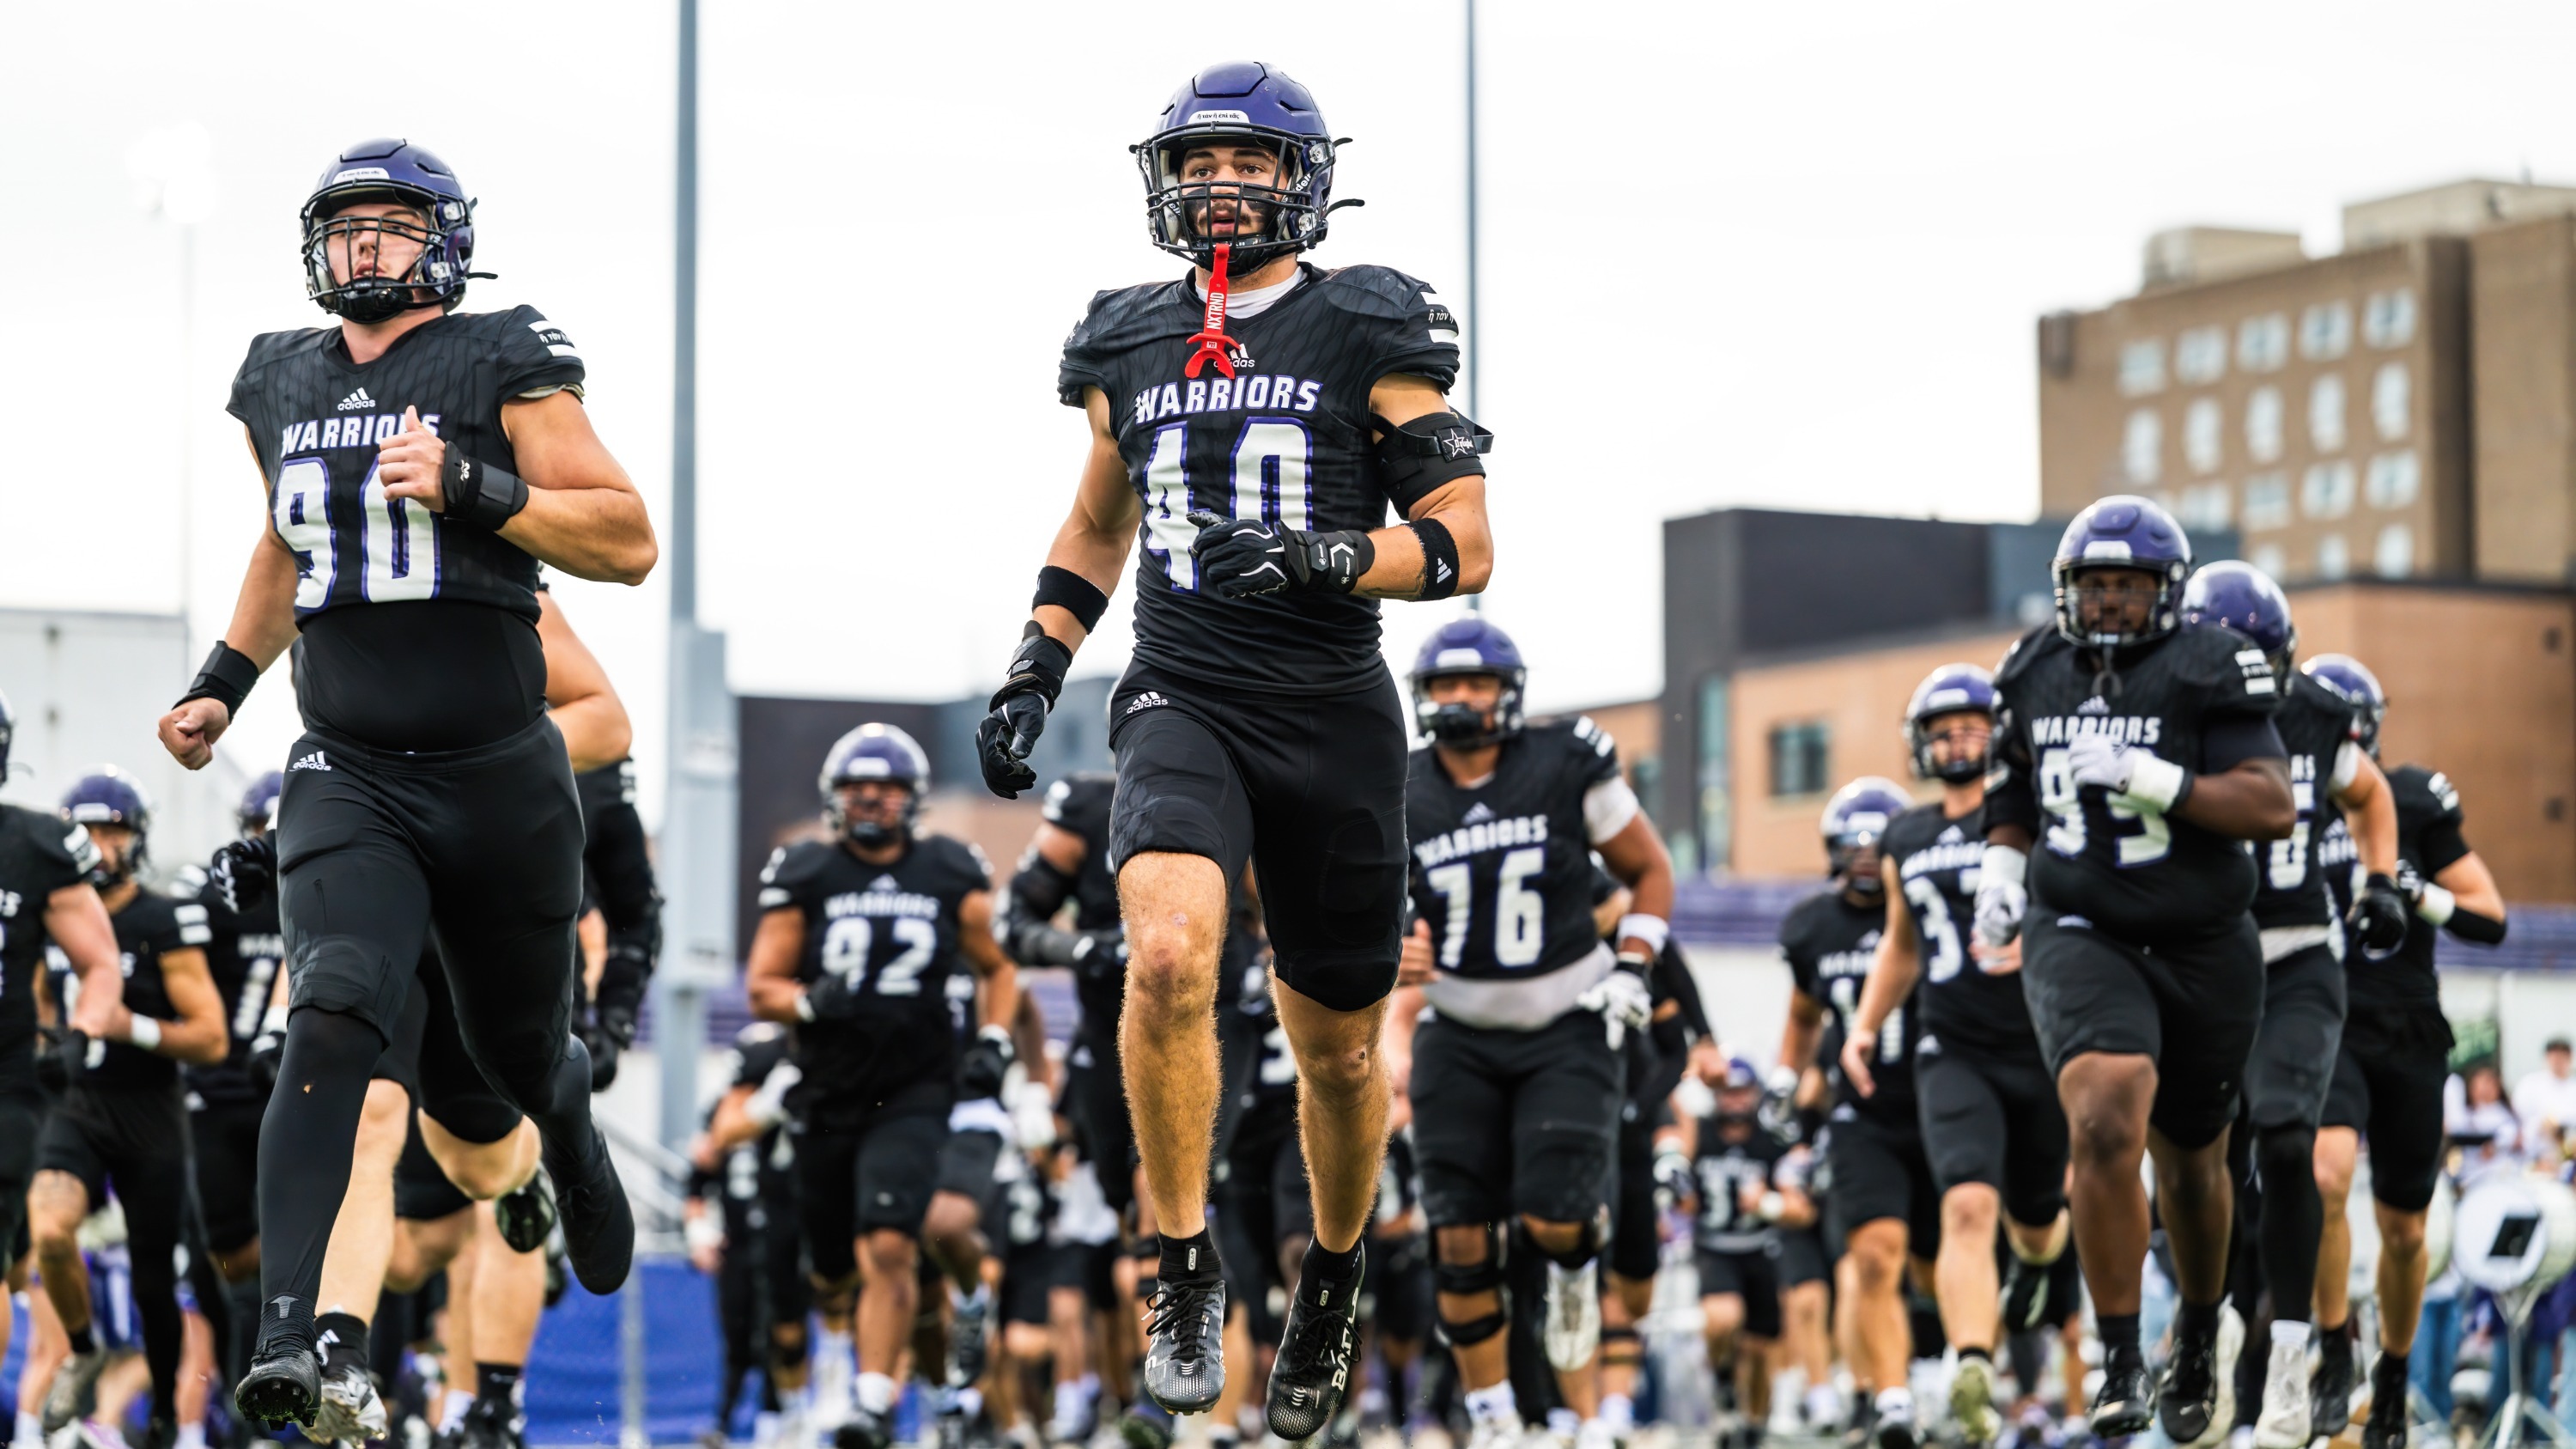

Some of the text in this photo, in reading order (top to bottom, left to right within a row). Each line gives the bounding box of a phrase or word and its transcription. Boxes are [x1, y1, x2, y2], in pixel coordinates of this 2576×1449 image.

[1206, 292, 1224, 330] NXTRND
[1213, 357, 1255, 368] adas
[337, 399, 376, 411] adidas
[1135, 374, 1323, 425] WARRIORS
[1143, 416, 1314, 594] 40
[274, 454, 441, 613] 90
[1126, 697, 1169, 714] adidas
[2032, 715, 2162, 746] WARRIORS
[1414, 813, 1548, 868] WARRIORS
[1426, 846, 1545, 969] 76
[822, 916, 938, 995] 92
